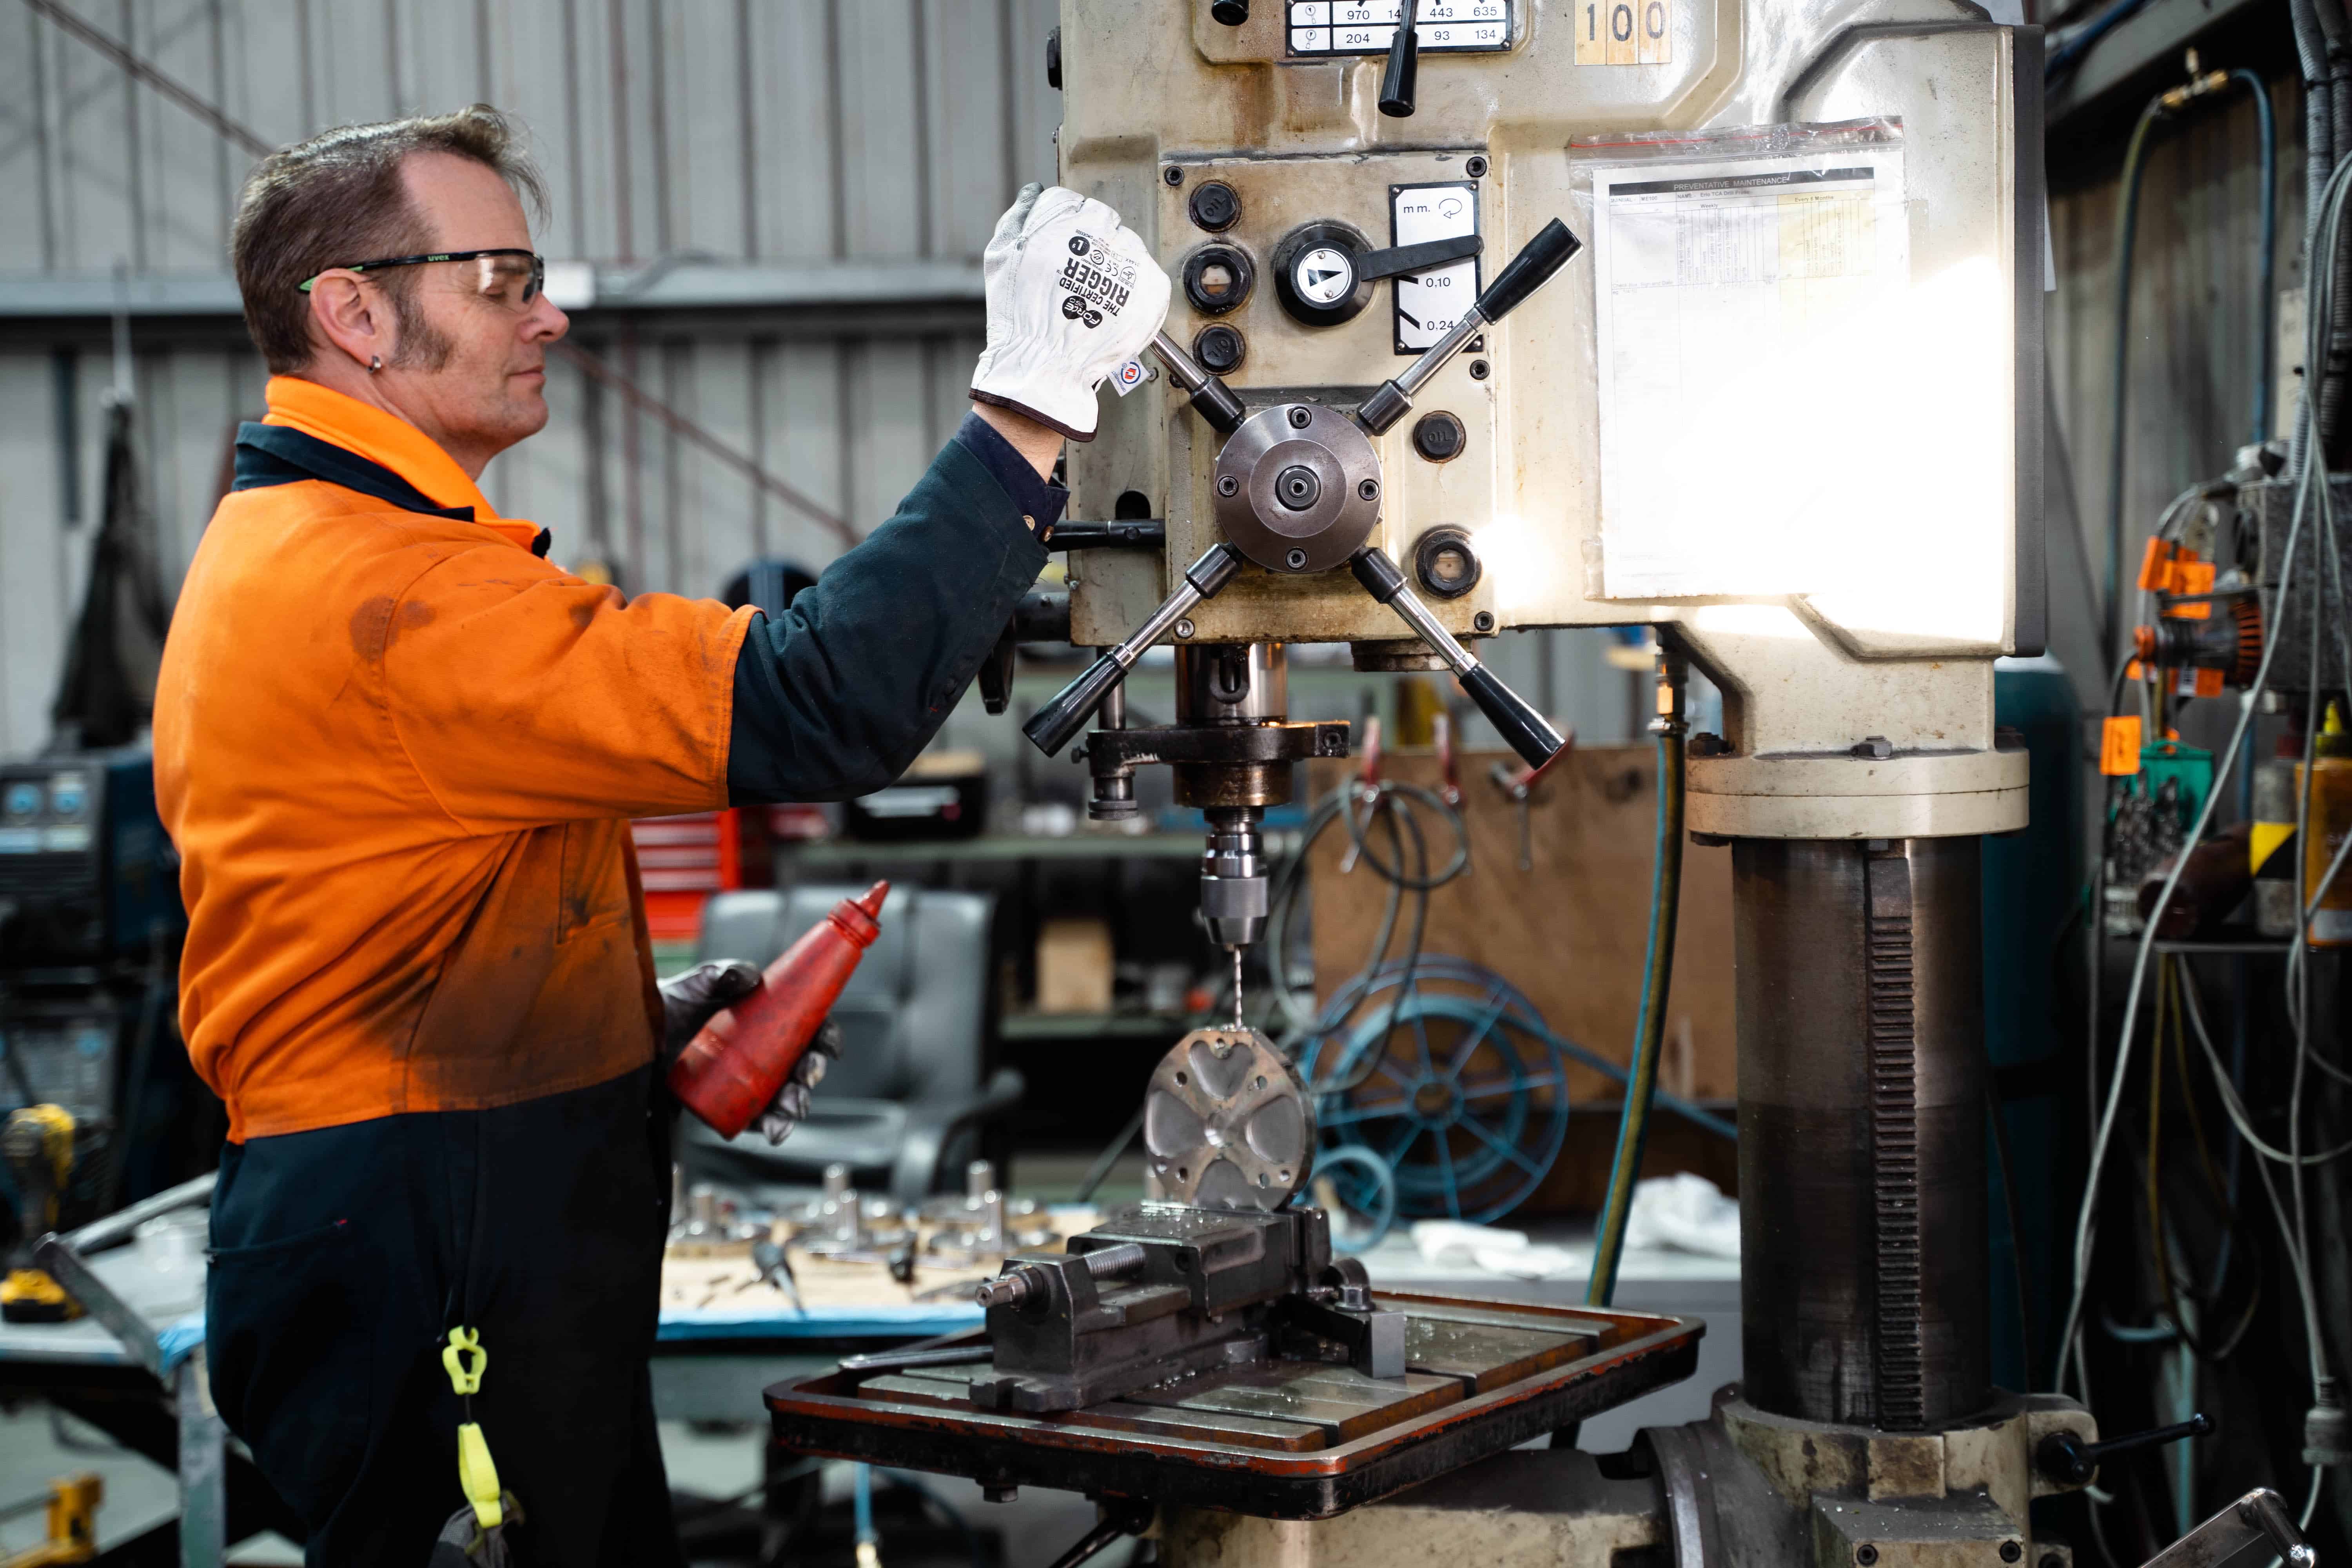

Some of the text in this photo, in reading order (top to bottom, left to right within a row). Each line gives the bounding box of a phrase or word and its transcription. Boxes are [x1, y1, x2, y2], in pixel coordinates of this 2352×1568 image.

[1347, 11, 1370, 20] 970
[1430, 8, 1453, 17] 443
[1474, 7, 1497, 16] 635
[1587, 1, 1666, 42] 100
[1346, 29, 1496, 44] 204 93 134
[1674, 176, 1788, 191] PREVENTATIVE MAINTENANCE
[1205, 197, 1226, 216] OIL
[1077, 239, 1084, 251] L
[1105, 263, 1118, 276] CE
[1063, 257, 1130, 307] RIGGER
[1426, 277, 1450, 288] 0,10
[1059, 277, 1120, 317] THE CERTIFIED
[1064, 301, 1101, 325] FORCE
[1427, 320, 1454, 331] 0,24
[1207, 339, 1230, 358] OIL
[1428, 431, 1453, 443] OIL
